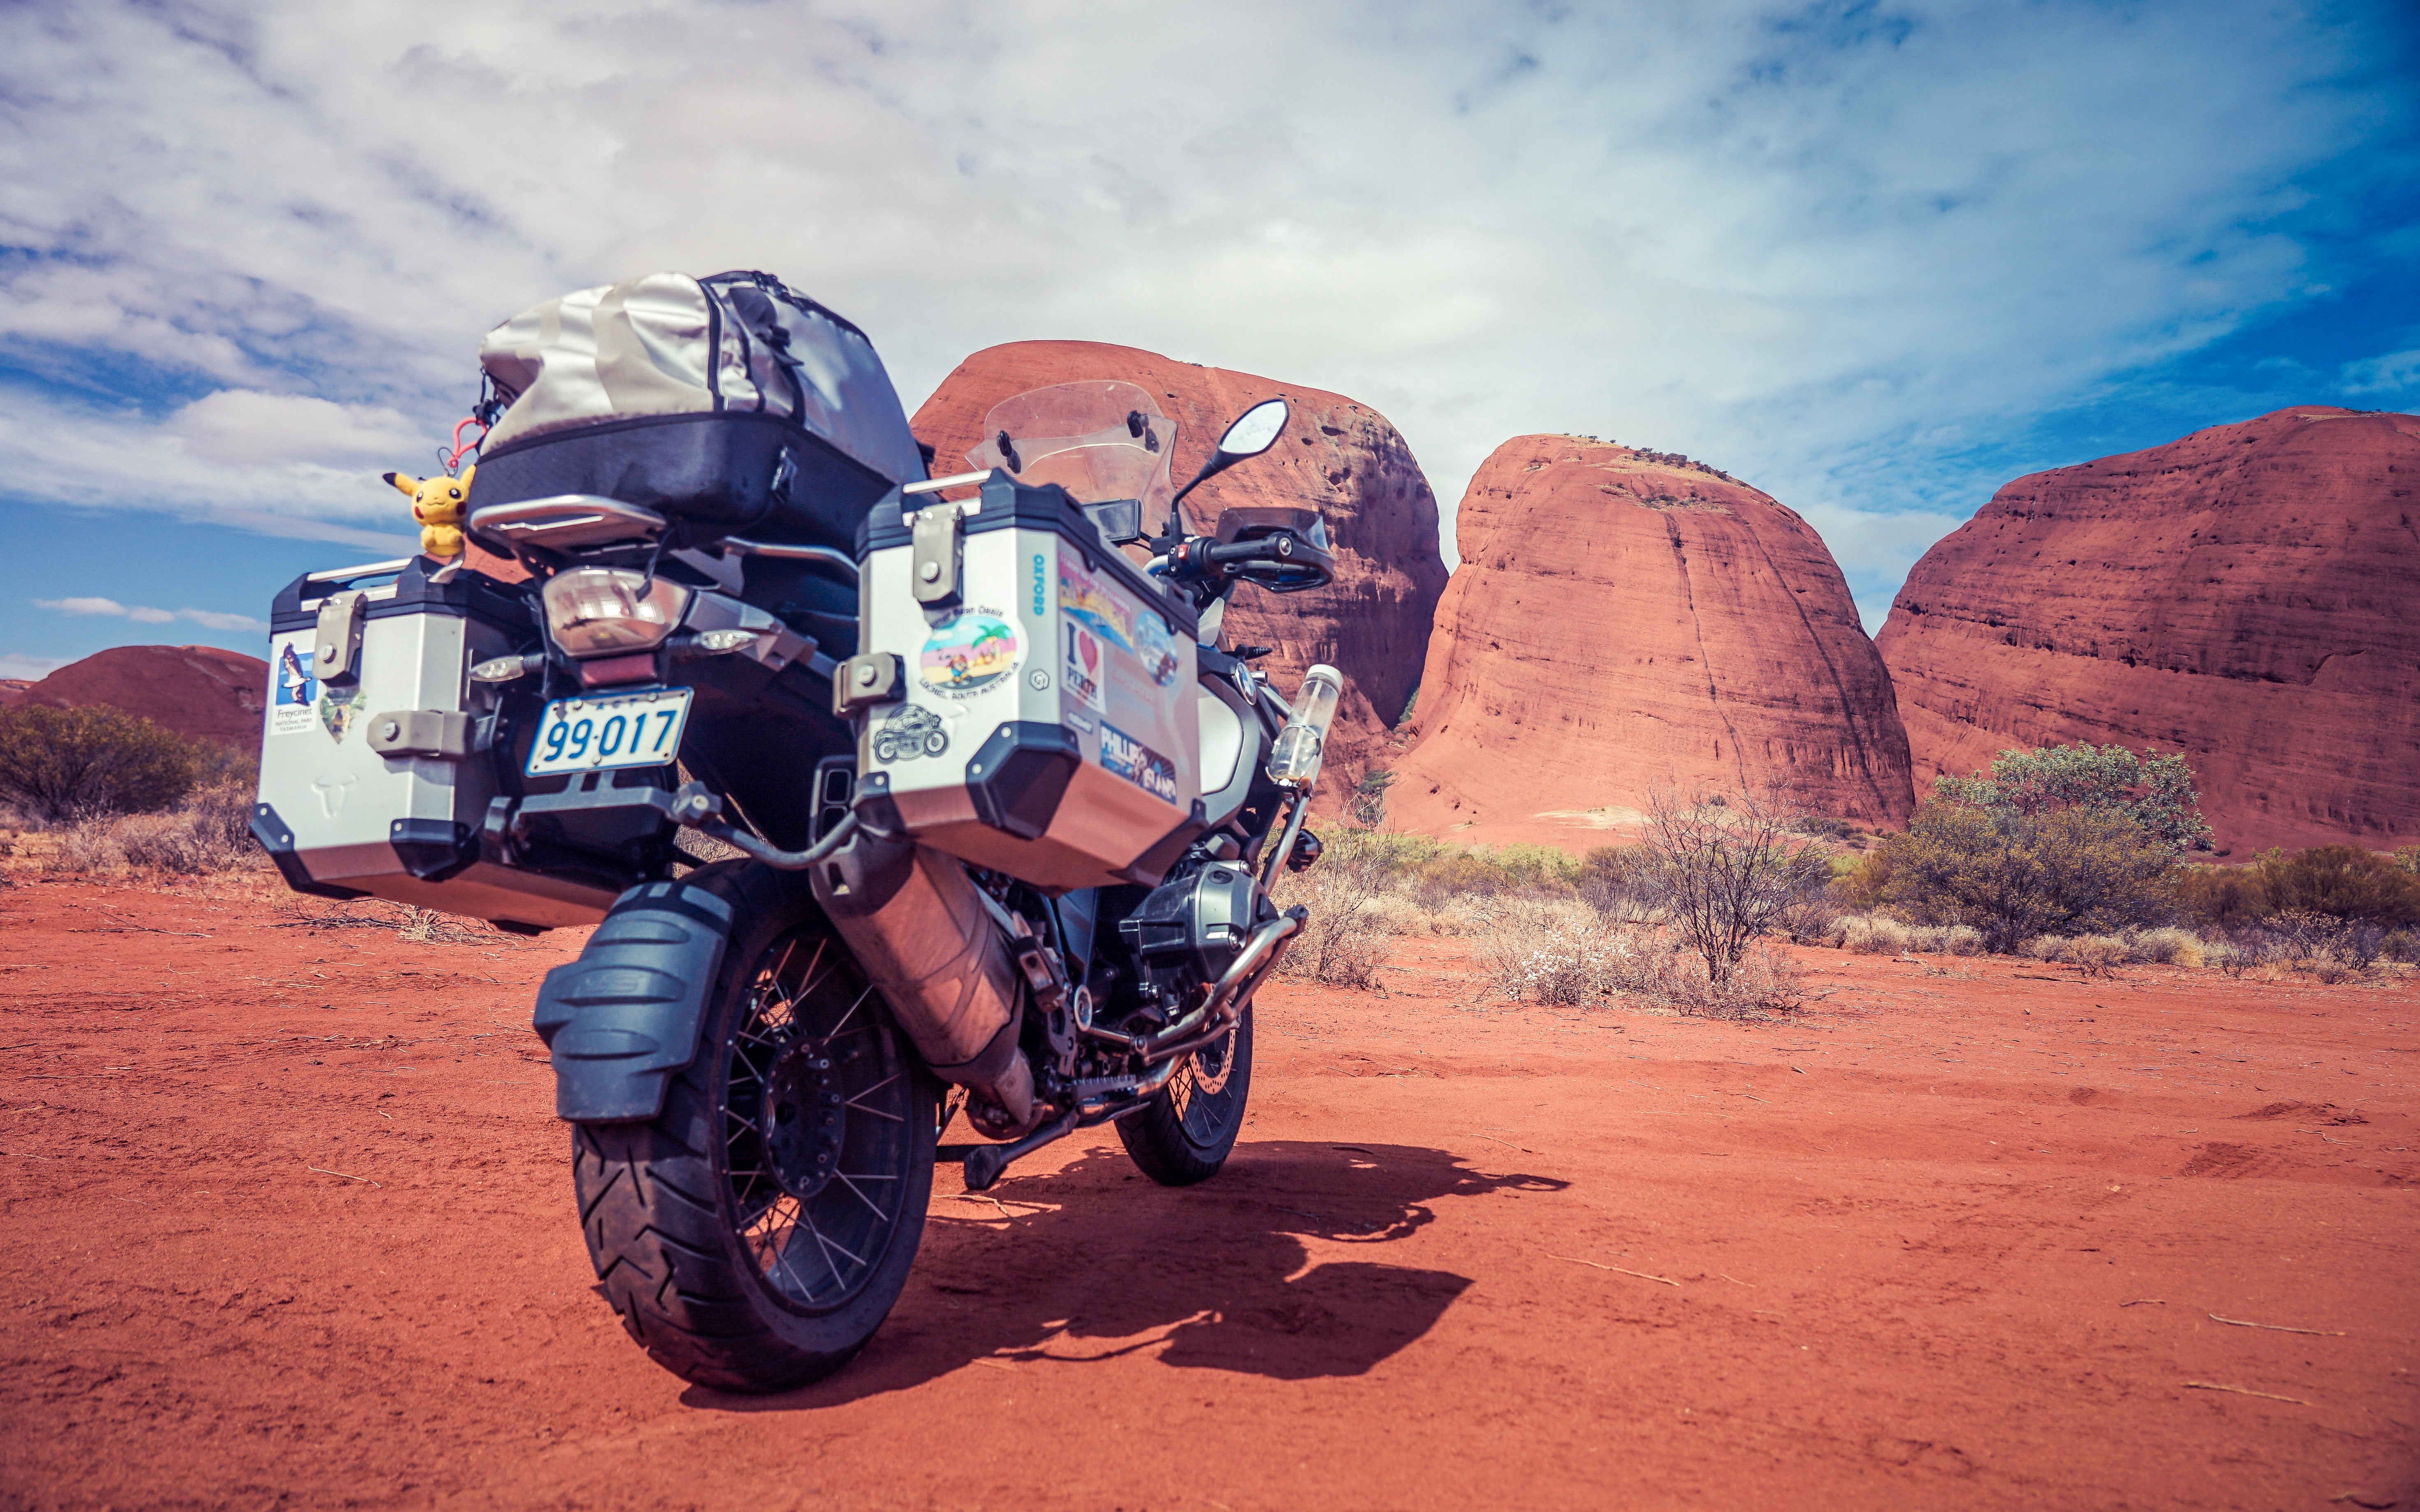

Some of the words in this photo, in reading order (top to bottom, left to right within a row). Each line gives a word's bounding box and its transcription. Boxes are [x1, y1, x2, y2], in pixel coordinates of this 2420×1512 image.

[1033, 554, 1044, 615] OXFORD
[1067, 622, 1076, 665] I
[981, 662, 1018, 694] AUSTRALIA
[278, 707, 313, 720] Freycinet
